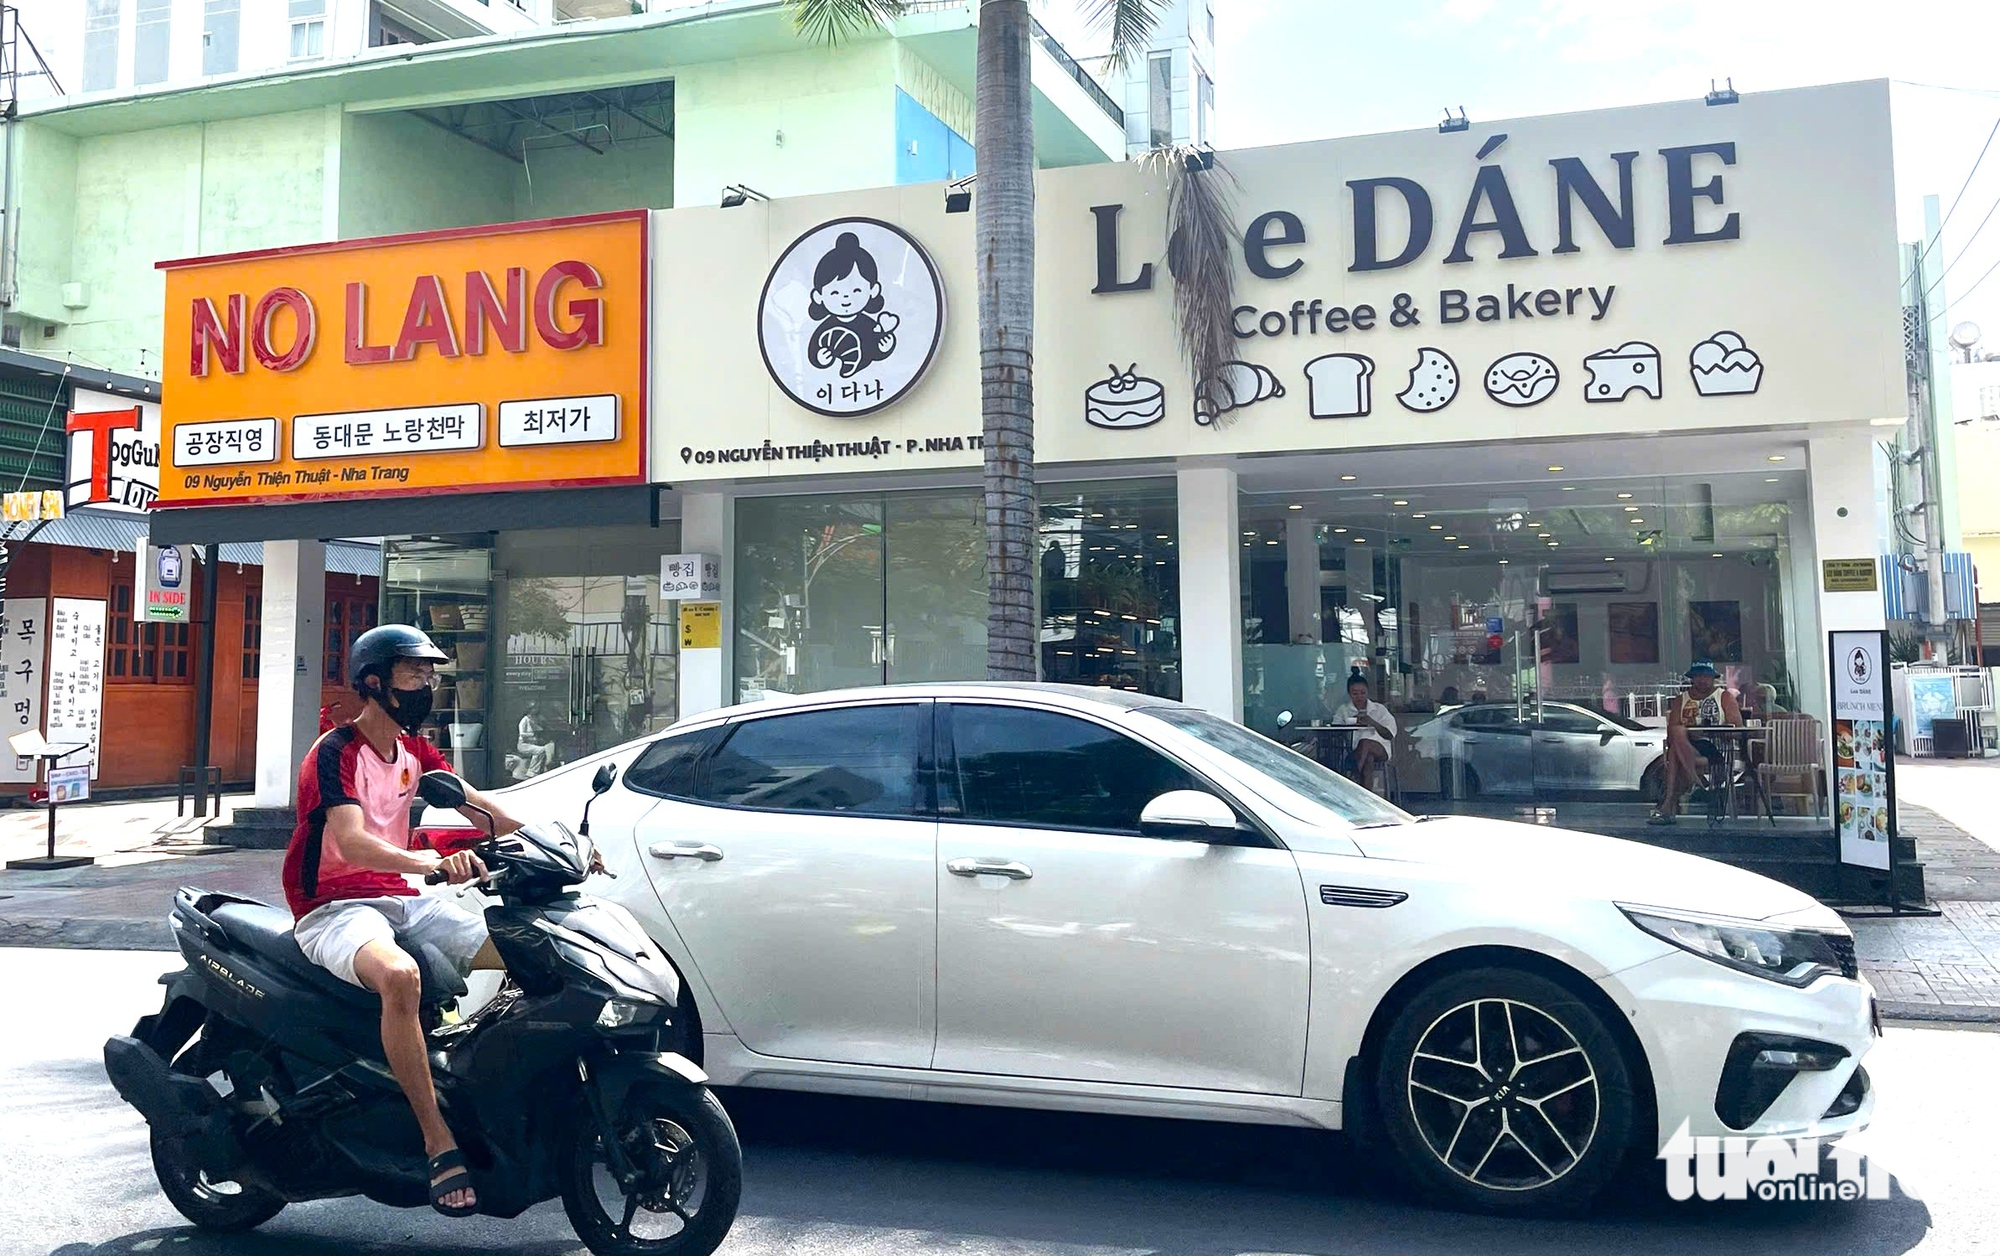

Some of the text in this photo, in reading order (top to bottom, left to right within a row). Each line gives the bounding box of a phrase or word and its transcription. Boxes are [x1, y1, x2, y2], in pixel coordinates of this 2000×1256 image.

[1345, 134, 1741, 273] DÁNE
[190, 260, 604, 377] NO LANG
[1231, 283, 1617, 339] Coffee & Bakery
[312, 416, 465, 450] 동대문 노랑천막
[523, 405, 591, 435] 최저가
[185, 426, 263, 457] 공장직영
[694, 451, 715, 464] 09
[718, 440, 783, 462] NGUYỄN
[786, 439, 834, 462] THIỆN
[837, 437, 891, 460] THUẬT
[185, 475, 200, 488] 09
[203, 470, 250, 491] Nguyễn
[257, 472, 290, 487] Thiện
[295, 470, 330, 485] Thuật
[341, 467, 366, 481] Nha
[371, 466, 409, 481] Trang
[669, 561, 695, 577] 빵집
[14, 618, 36, 725] 목구멍
[515, 655, 555, 665] HOURS
